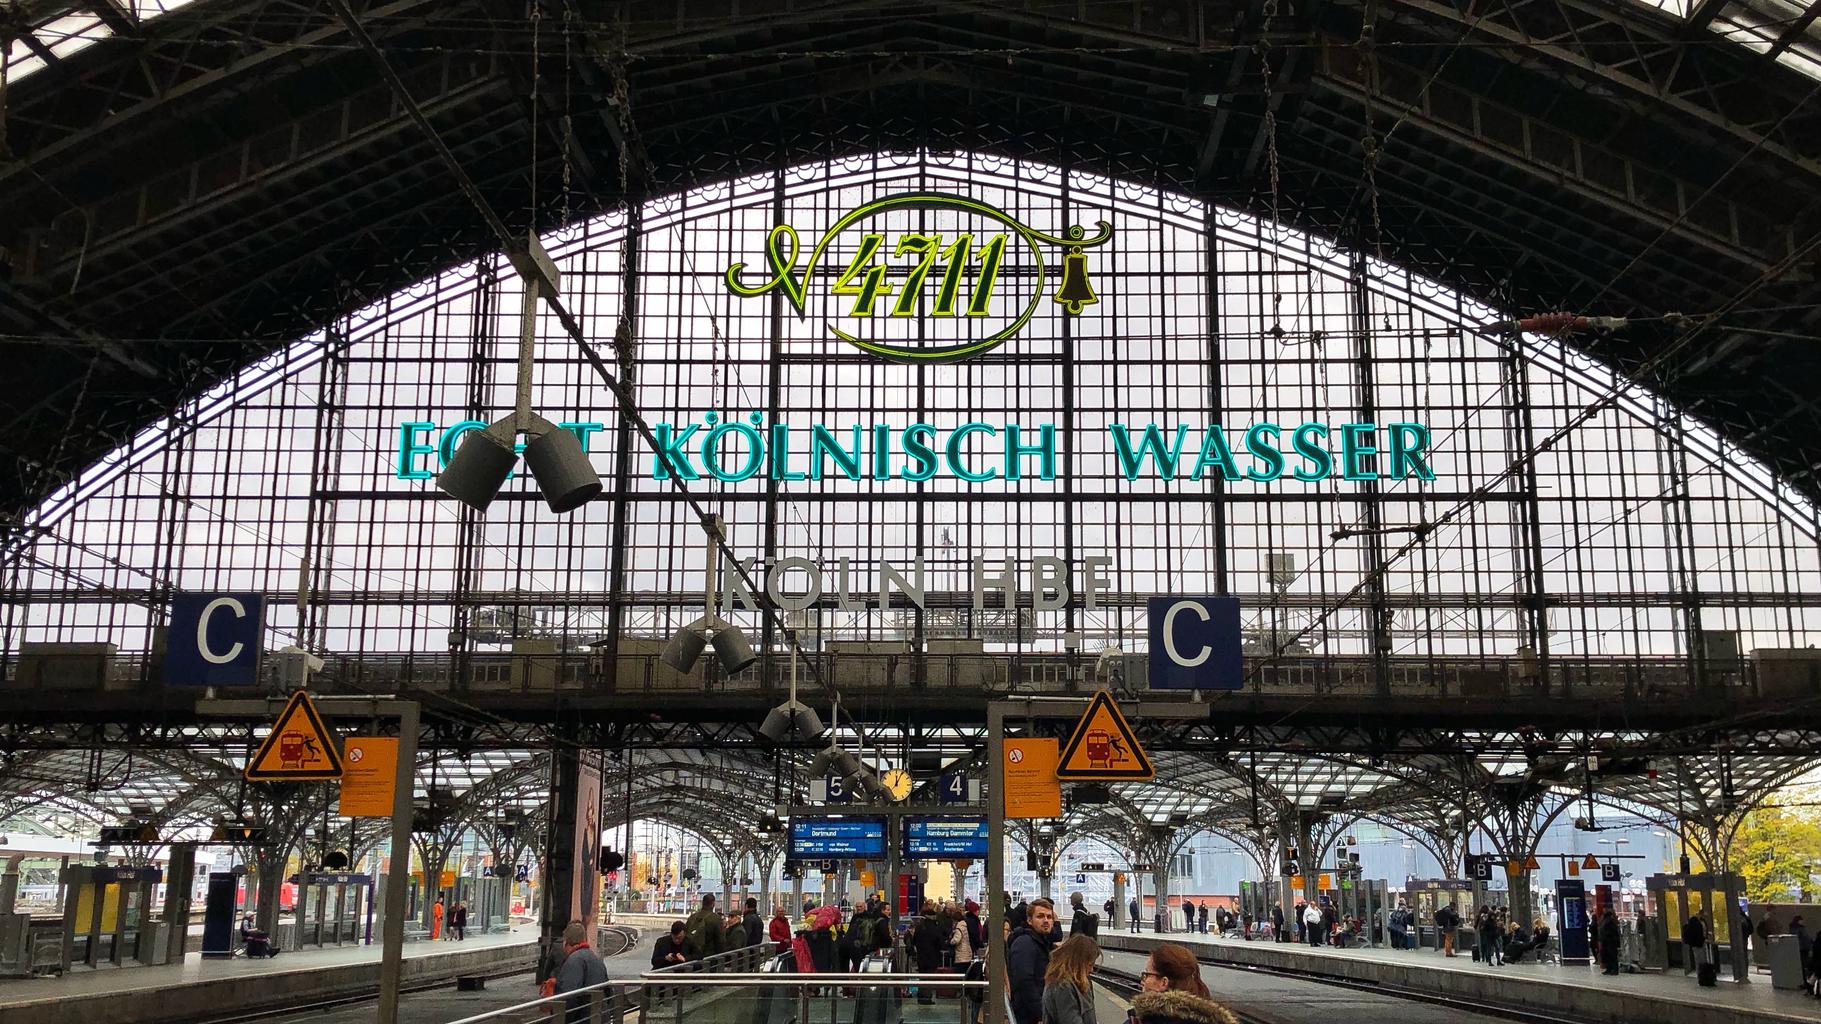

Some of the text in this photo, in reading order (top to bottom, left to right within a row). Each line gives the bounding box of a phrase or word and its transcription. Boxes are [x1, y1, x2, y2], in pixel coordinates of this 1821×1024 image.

[831, 234, 1010, 318] 4711
[396, 410, 1437, 483] ECT KÖLNISCH WASSER
[721, 554, 1113, 612] KÖLN HBF
[197, 597, 246, 664] C
[1162, 600, 1213, 668] C
[830, 776, 843, 797] 5
[949, 775, 963, 796] 4
[822, 859, 832, 870] B
[1477, 863, 1487, 877] B
[1605, 865, 1615, 878] B
[1077, 874, 1084, 882] A
